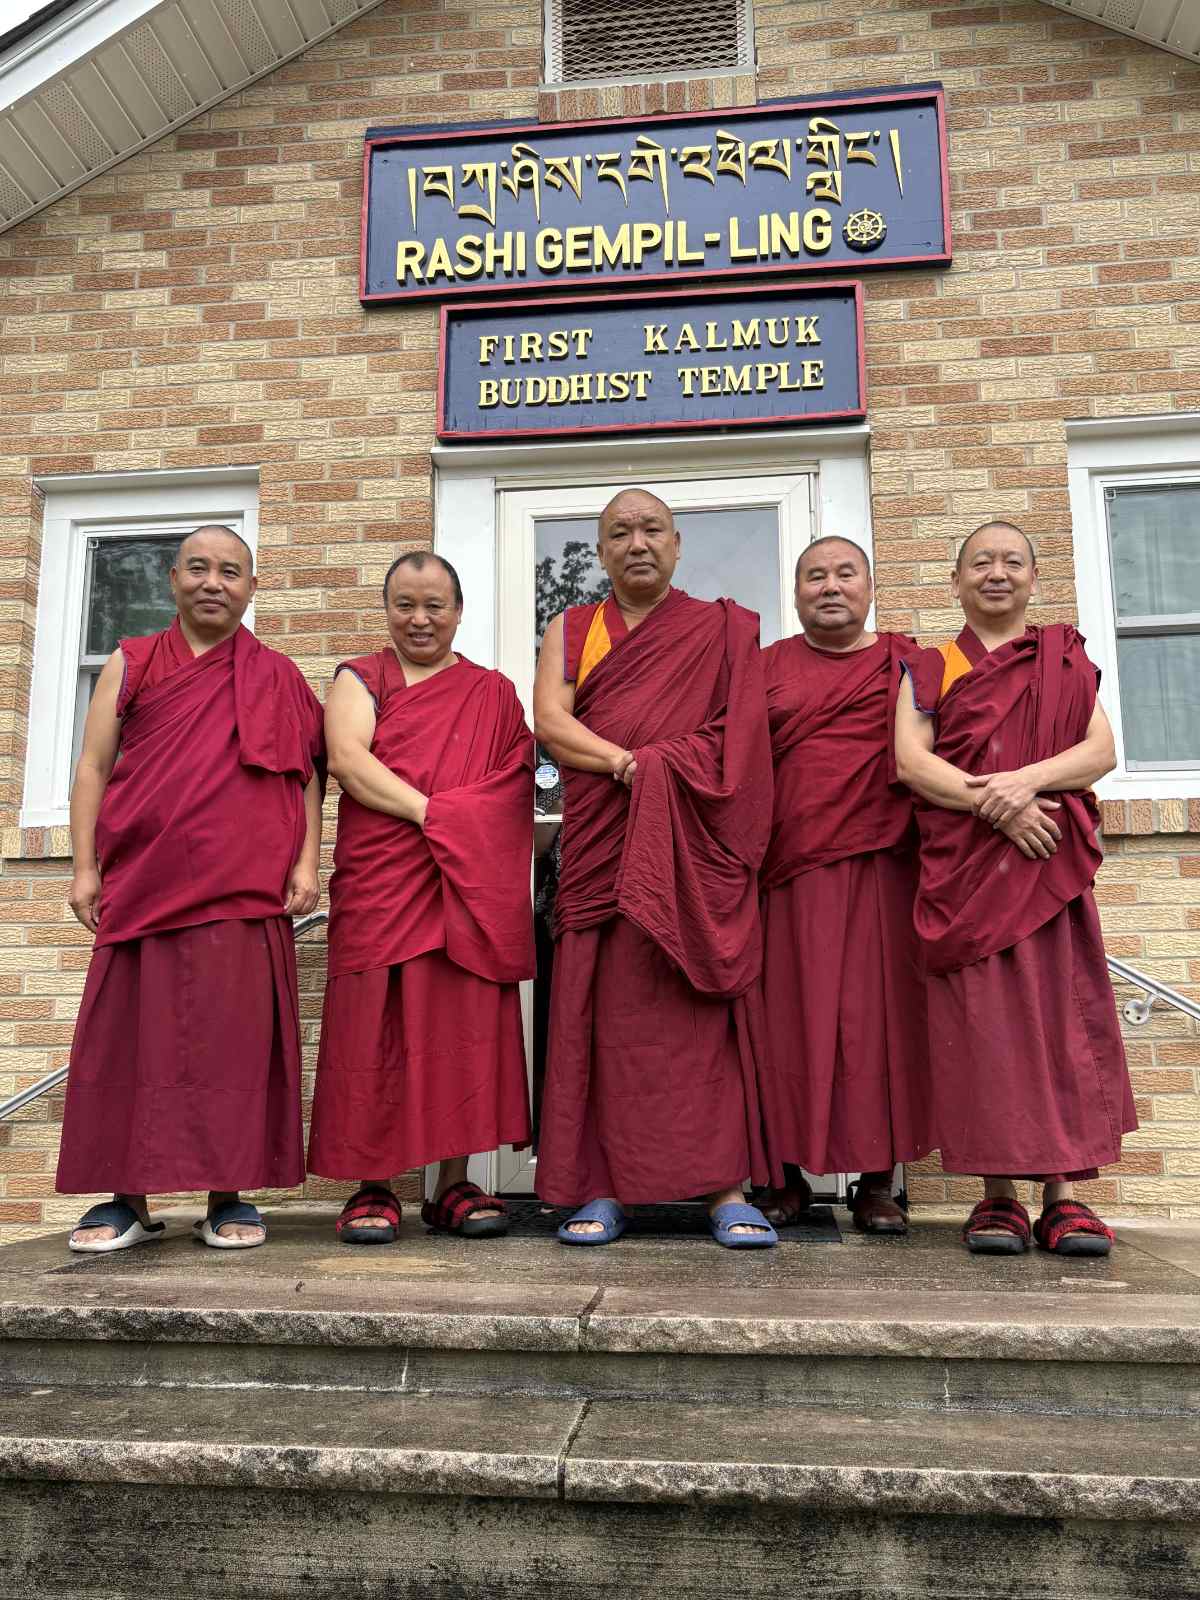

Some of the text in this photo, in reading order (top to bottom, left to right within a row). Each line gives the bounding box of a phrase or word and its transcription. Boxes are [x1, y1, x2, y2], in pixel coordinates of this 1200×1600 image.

[396, 231, 526, 282] RASHI
[478, 315, 822, 365] FIRST KALMUK
[478, 360, 825, 408] BUDDHIST TEMPLE
